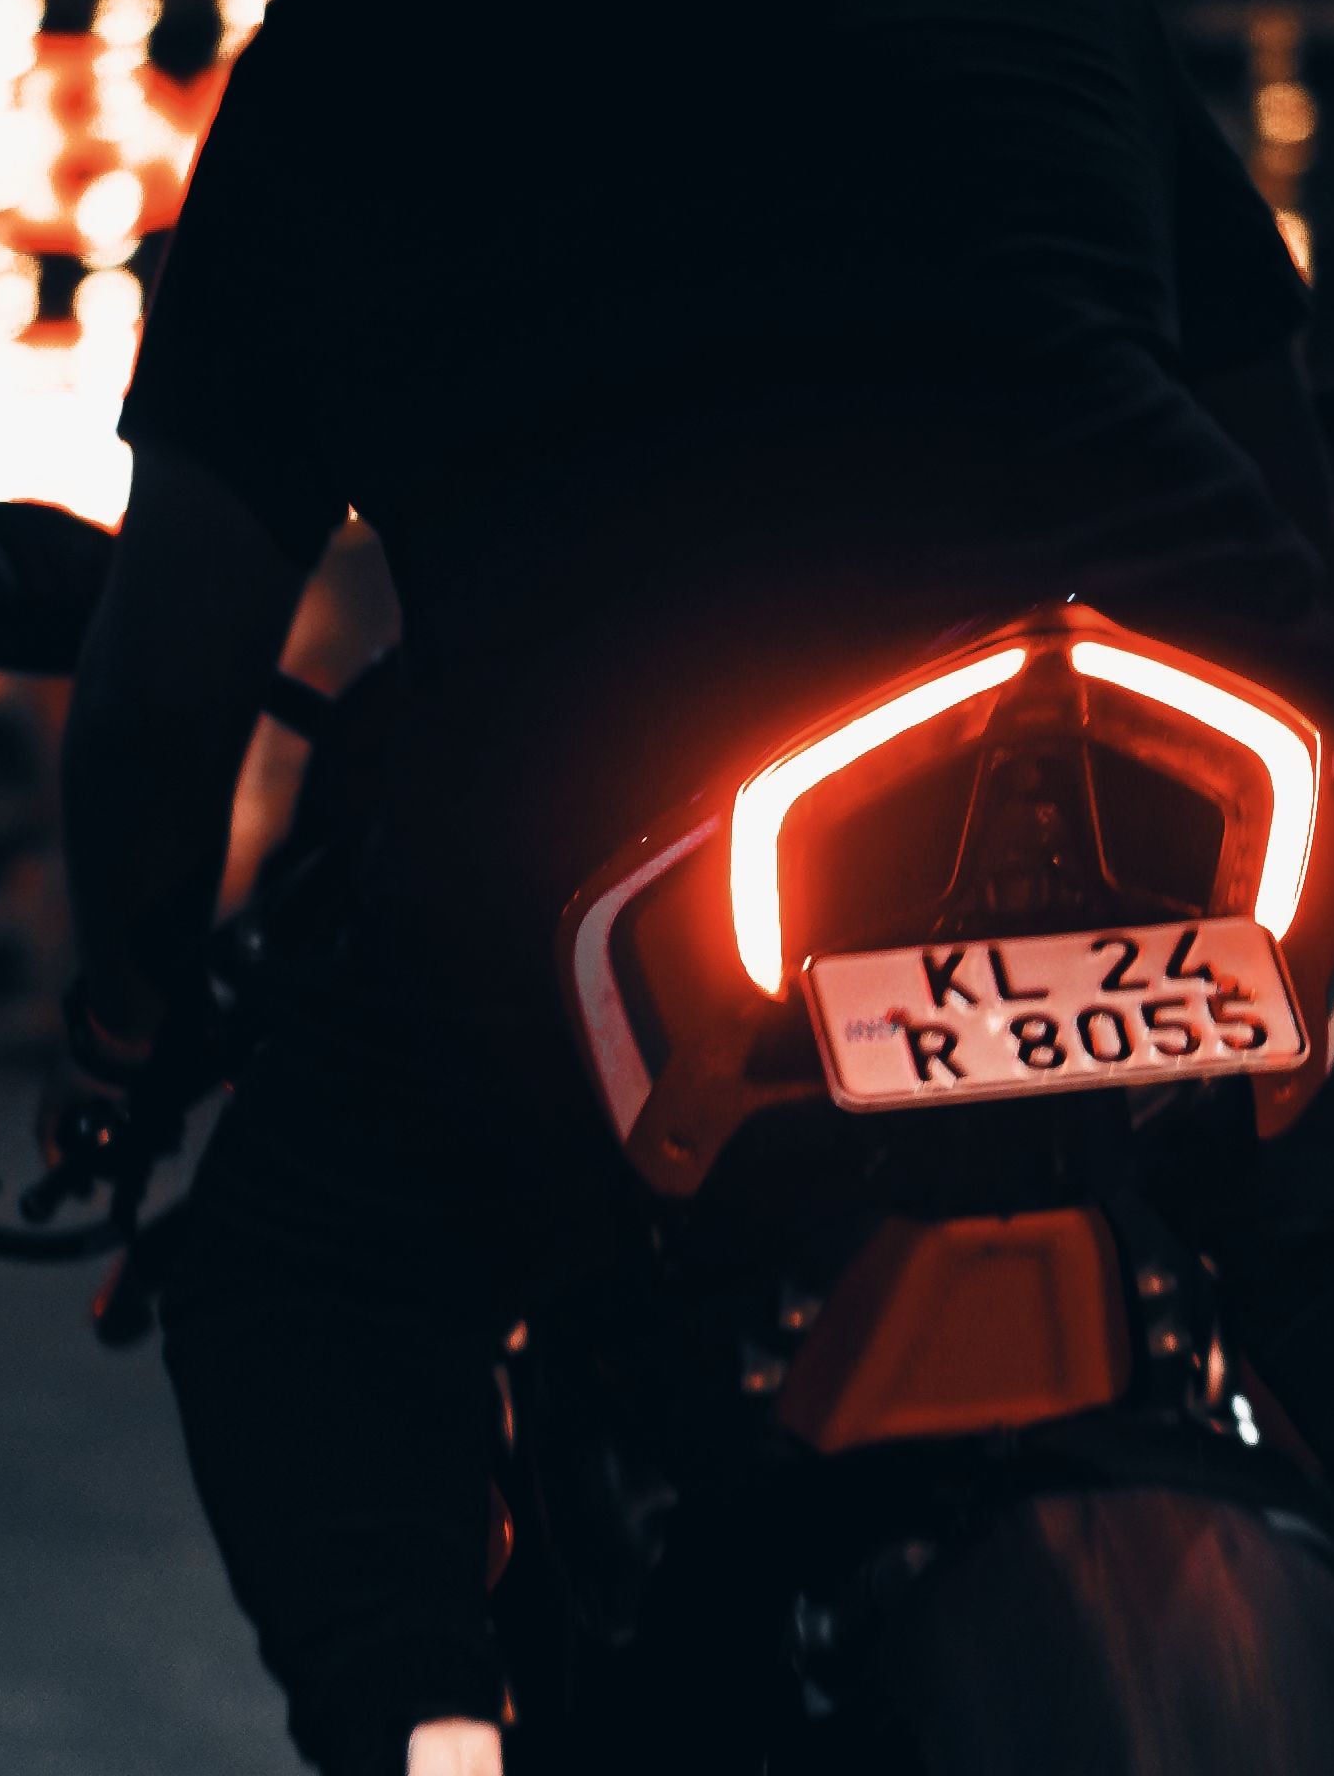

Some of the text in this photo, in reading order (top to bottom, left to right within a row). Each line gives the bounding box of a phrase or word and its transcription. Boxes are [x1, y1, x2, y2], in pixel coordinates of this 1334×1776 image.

[921, 926, 1216, 1008] KL 24
[905, 992, 1269, 1082] R 8055
